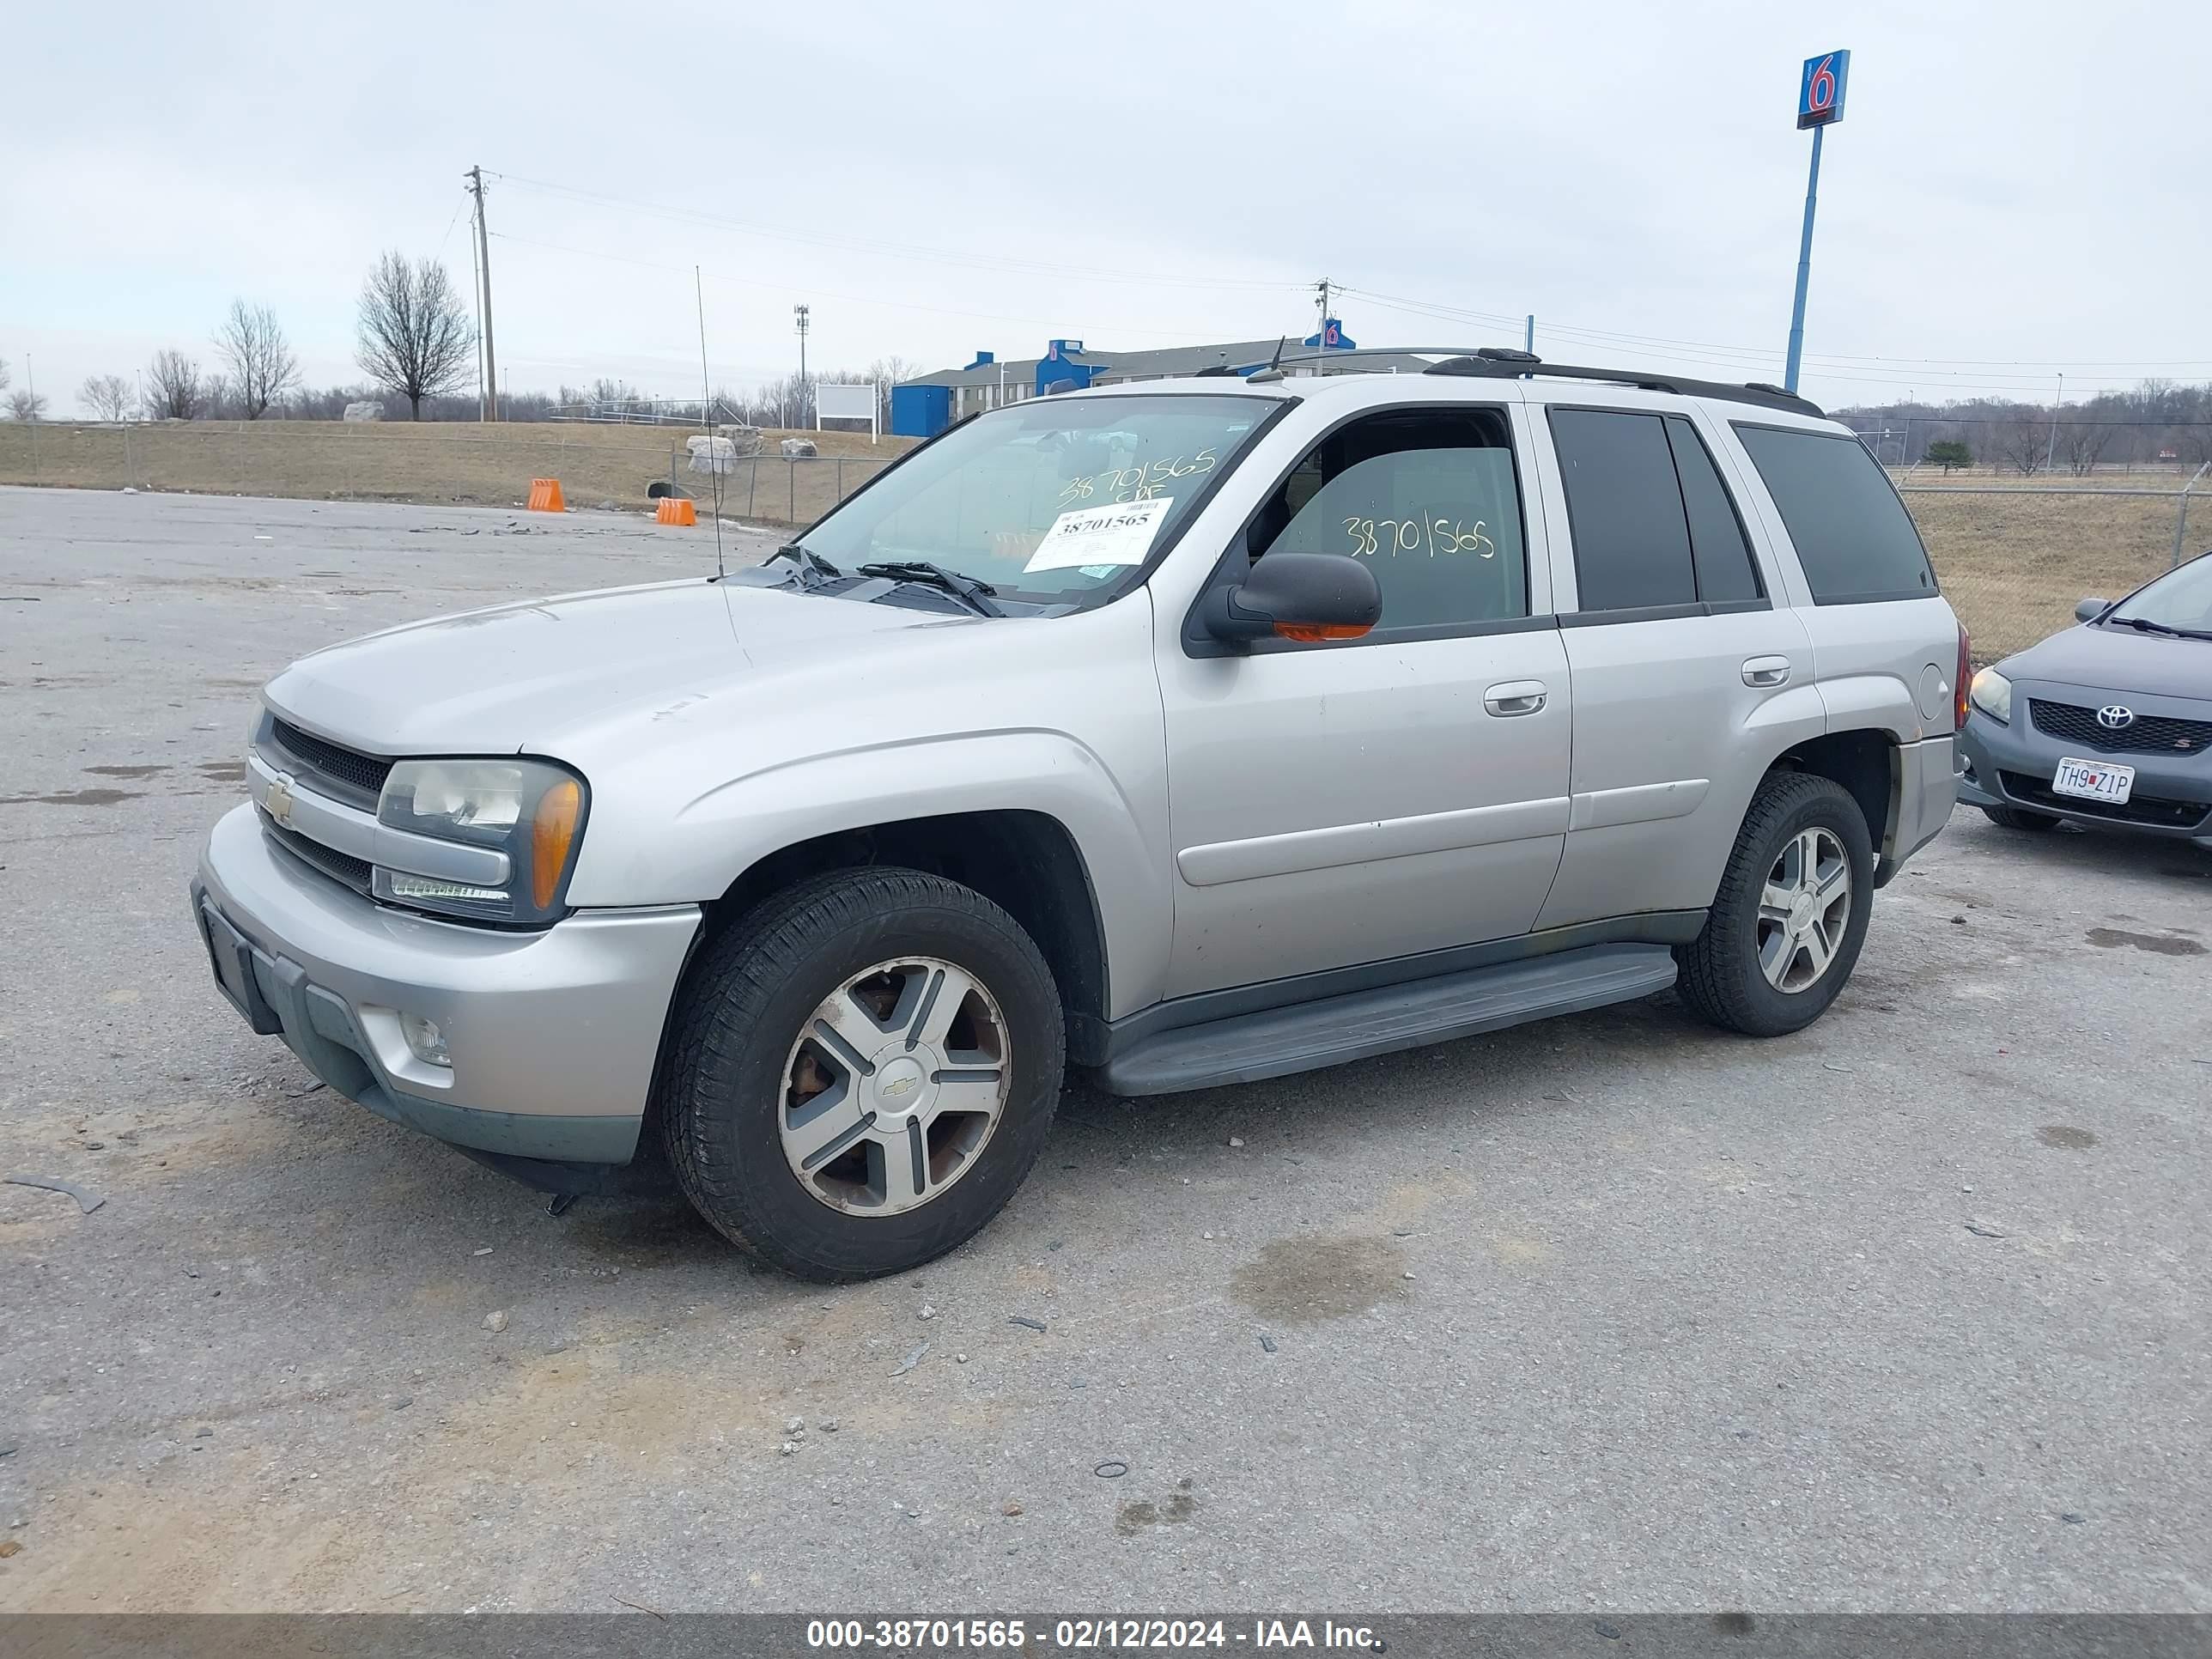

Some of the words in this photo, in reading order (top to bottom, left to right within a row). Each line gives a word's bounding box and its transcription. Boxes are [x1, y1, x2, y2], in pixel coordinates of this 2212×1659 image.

[1808, 54, 1835, 111] 6
[1327, 324, 1339, 344] 6
[1057, 513, 1152, 536] 38701565
[1340, 508, 1495, 558] 38701565
[2060, 765, 2089, 787] TH9
[2095, 772, 2128, 795] Z1P
